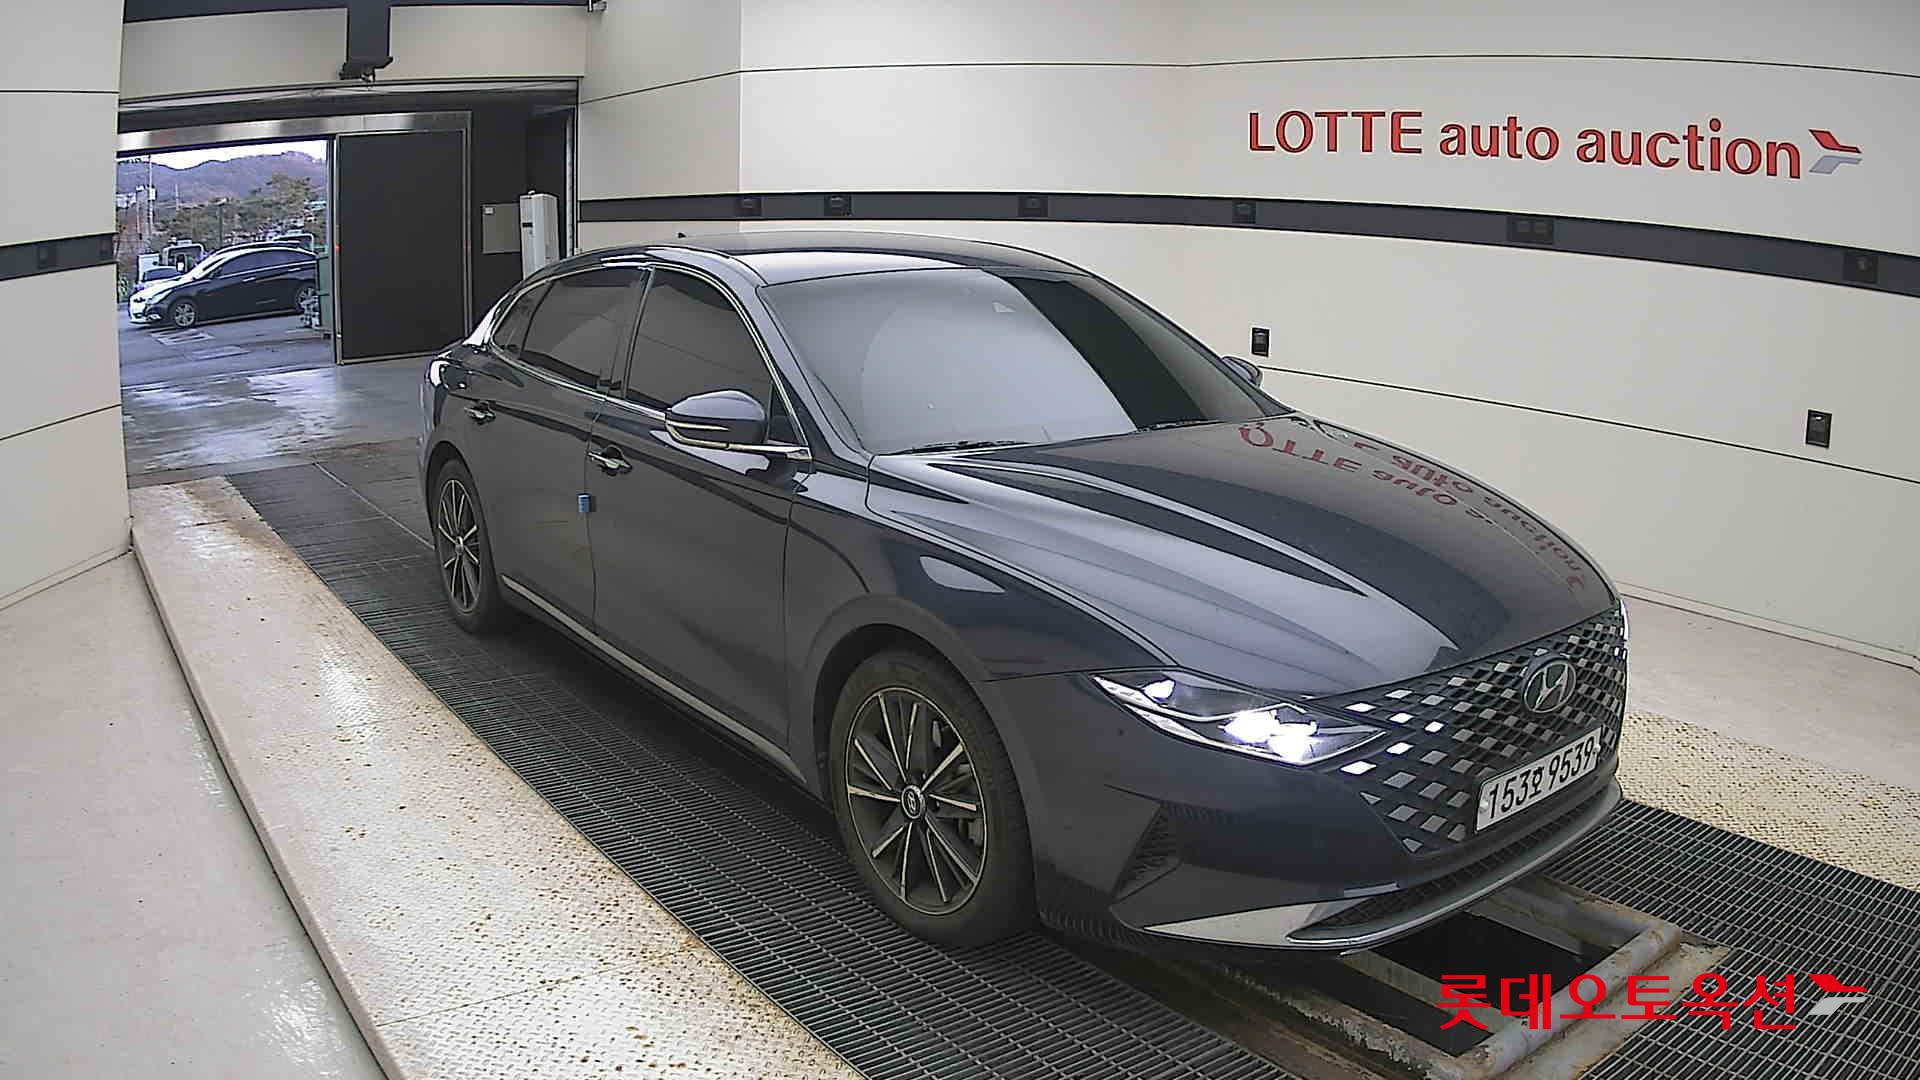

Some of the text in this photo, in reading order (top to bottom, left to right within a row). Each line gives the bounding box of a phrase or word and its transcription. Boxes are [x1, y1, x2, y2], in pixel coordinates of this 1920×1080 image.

[1249, 111, 1801, 179] LOTTE auto auction
[1548, 736, 1596, 791] 9539
